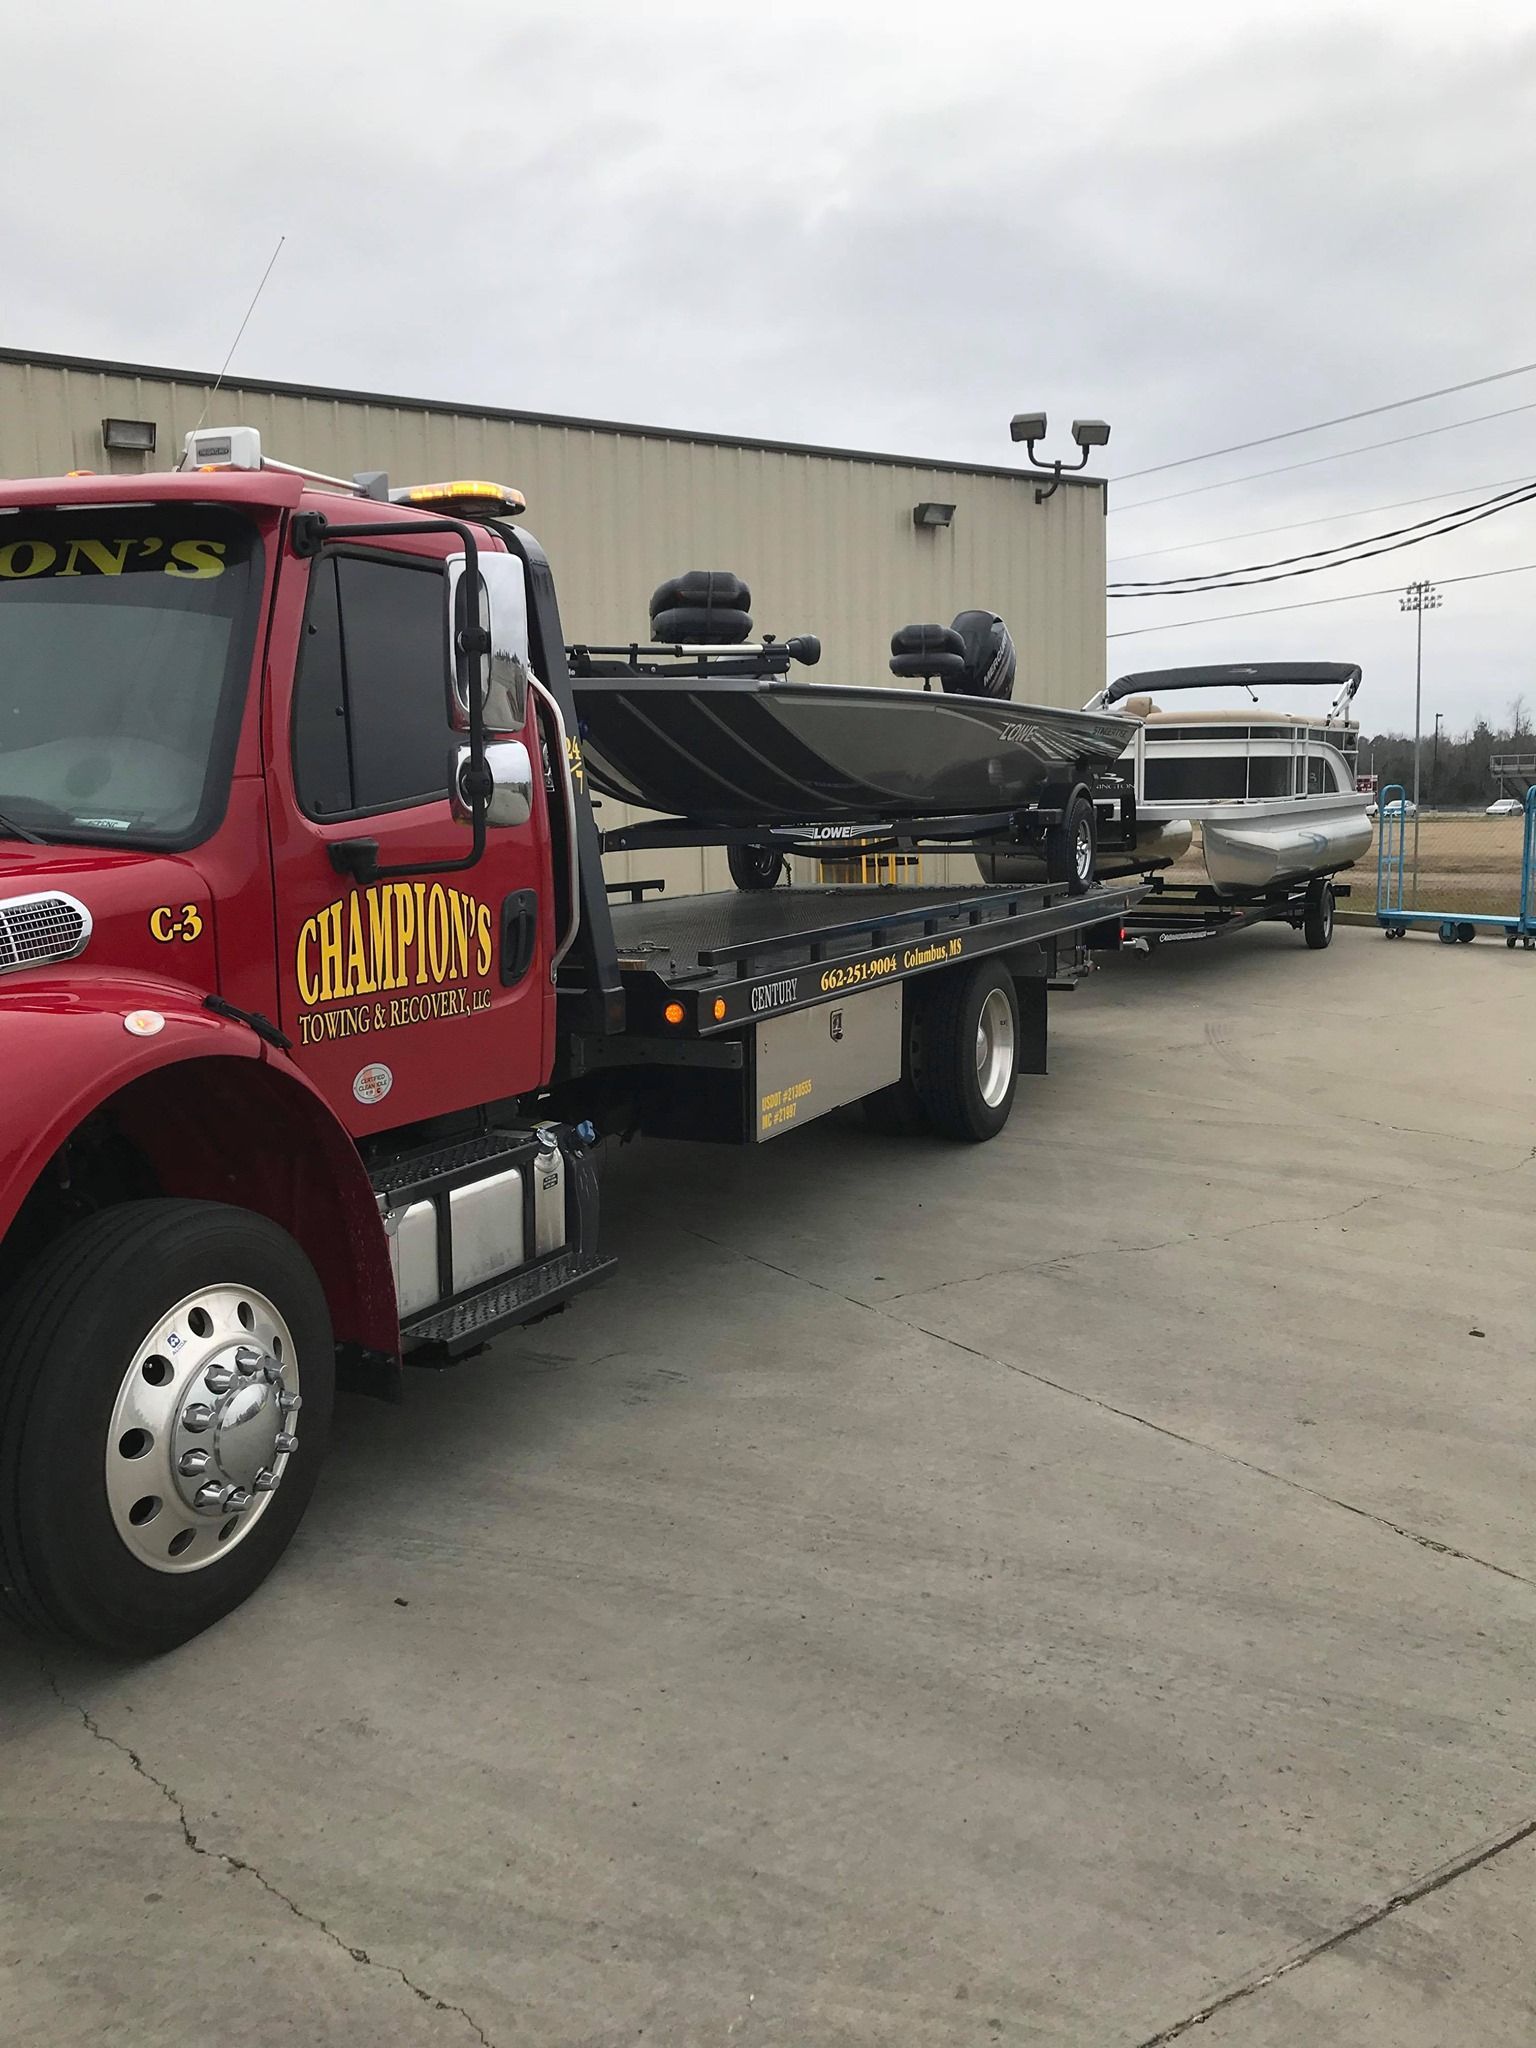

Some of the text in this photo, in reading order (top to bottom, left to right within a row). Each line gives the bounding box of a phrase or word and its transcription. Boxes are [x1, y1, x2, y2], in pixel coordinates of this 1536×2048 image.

[1000, 723, 1038, 742] LOWE
[813, 826, 851, 839] LOWE
[149, 904, 203, 942] C-3
[296, 882, 492, 1005] CHAMPION'S
[903, 944, 949, 968] Columbus,
[949, 937, 962, 957] MS
[751, 977, 798, 1012] CENTURY
[298, 987, 491, 1045] TOWING & RECOVERY, LLC
[762, 1091, 781, 1111] USDOT
[762, 1112, 772, 1130] MC
